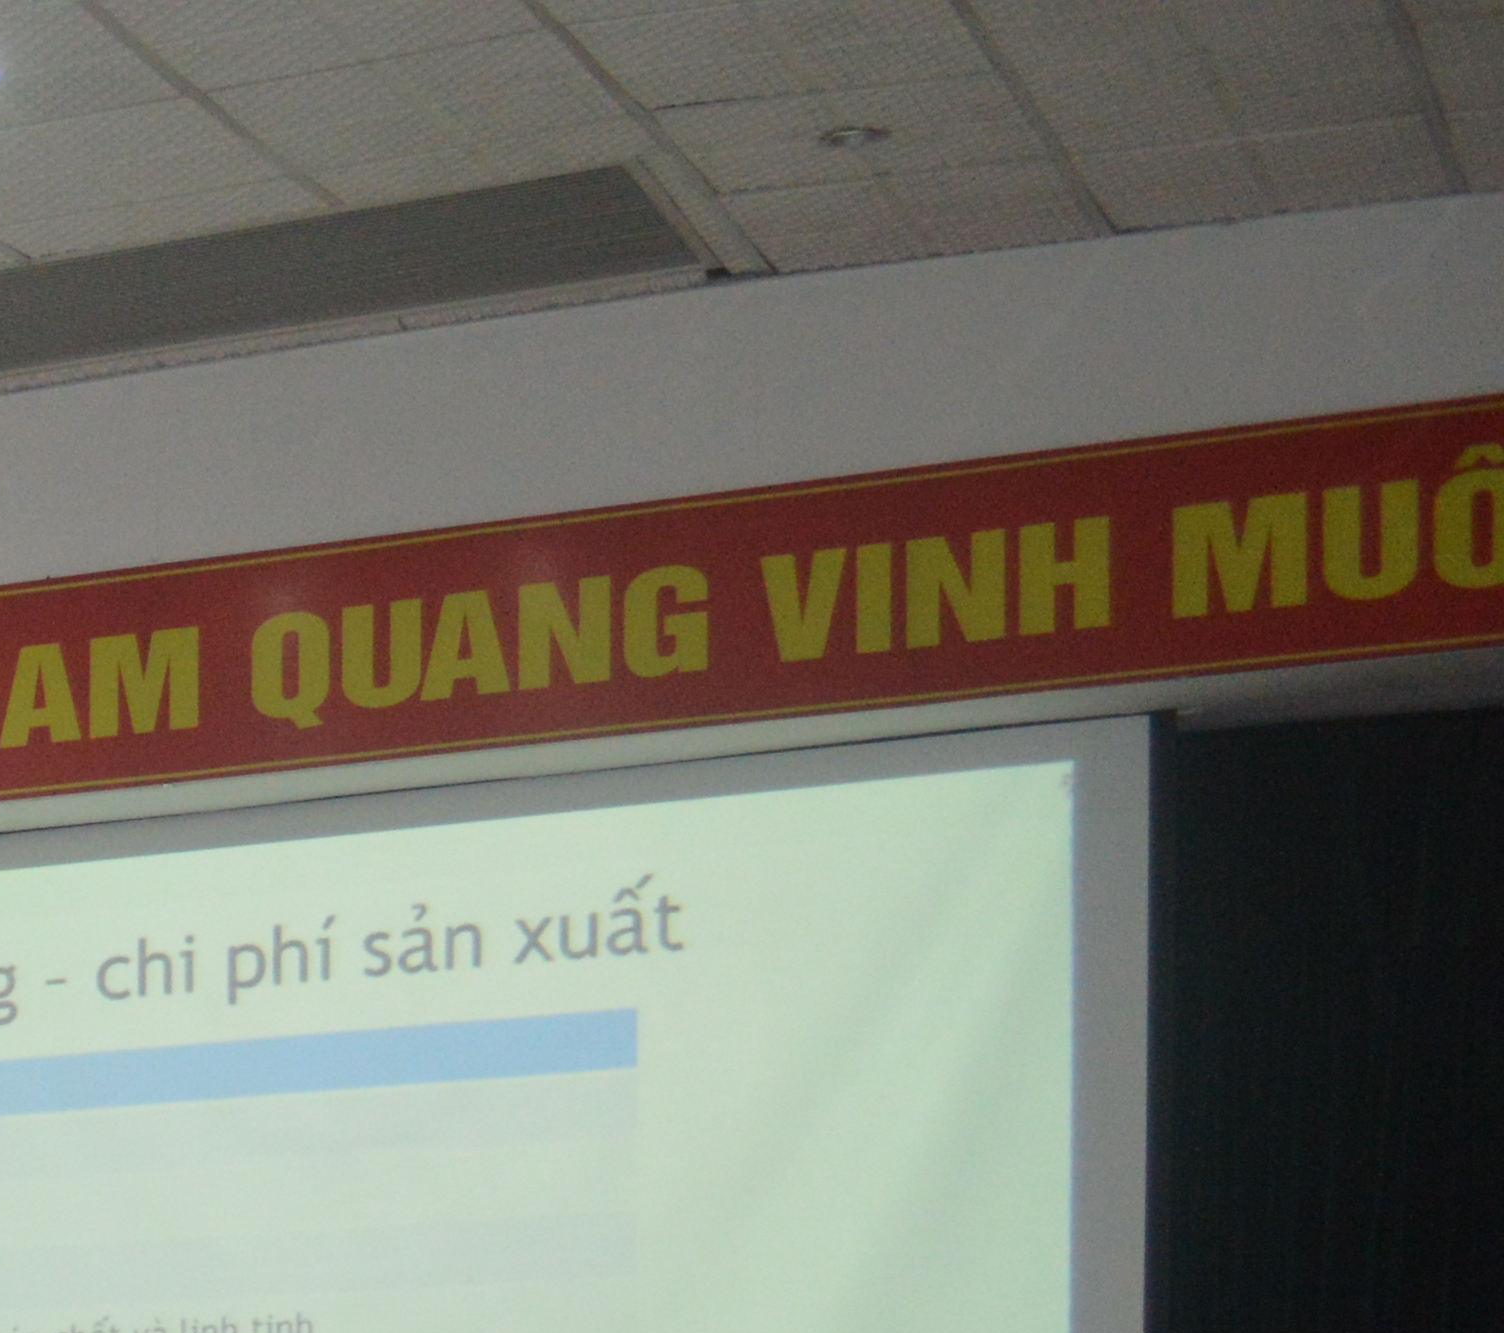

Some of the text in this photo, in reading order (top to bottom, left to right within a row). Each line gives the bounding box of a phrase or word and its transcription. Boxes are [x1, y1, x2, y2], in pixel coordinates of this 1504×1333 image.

[250, 565, 710, 731] QUANG
[762, 516, 1111, 665] VINH
[1173, 442, 1504, 619] MUÔ
[95, 935, 195, 1000] chi
[226, 914, 337, 1005] phí
[363, 903, 482, 978] sản
[513, 873, 685, 964] xuất
